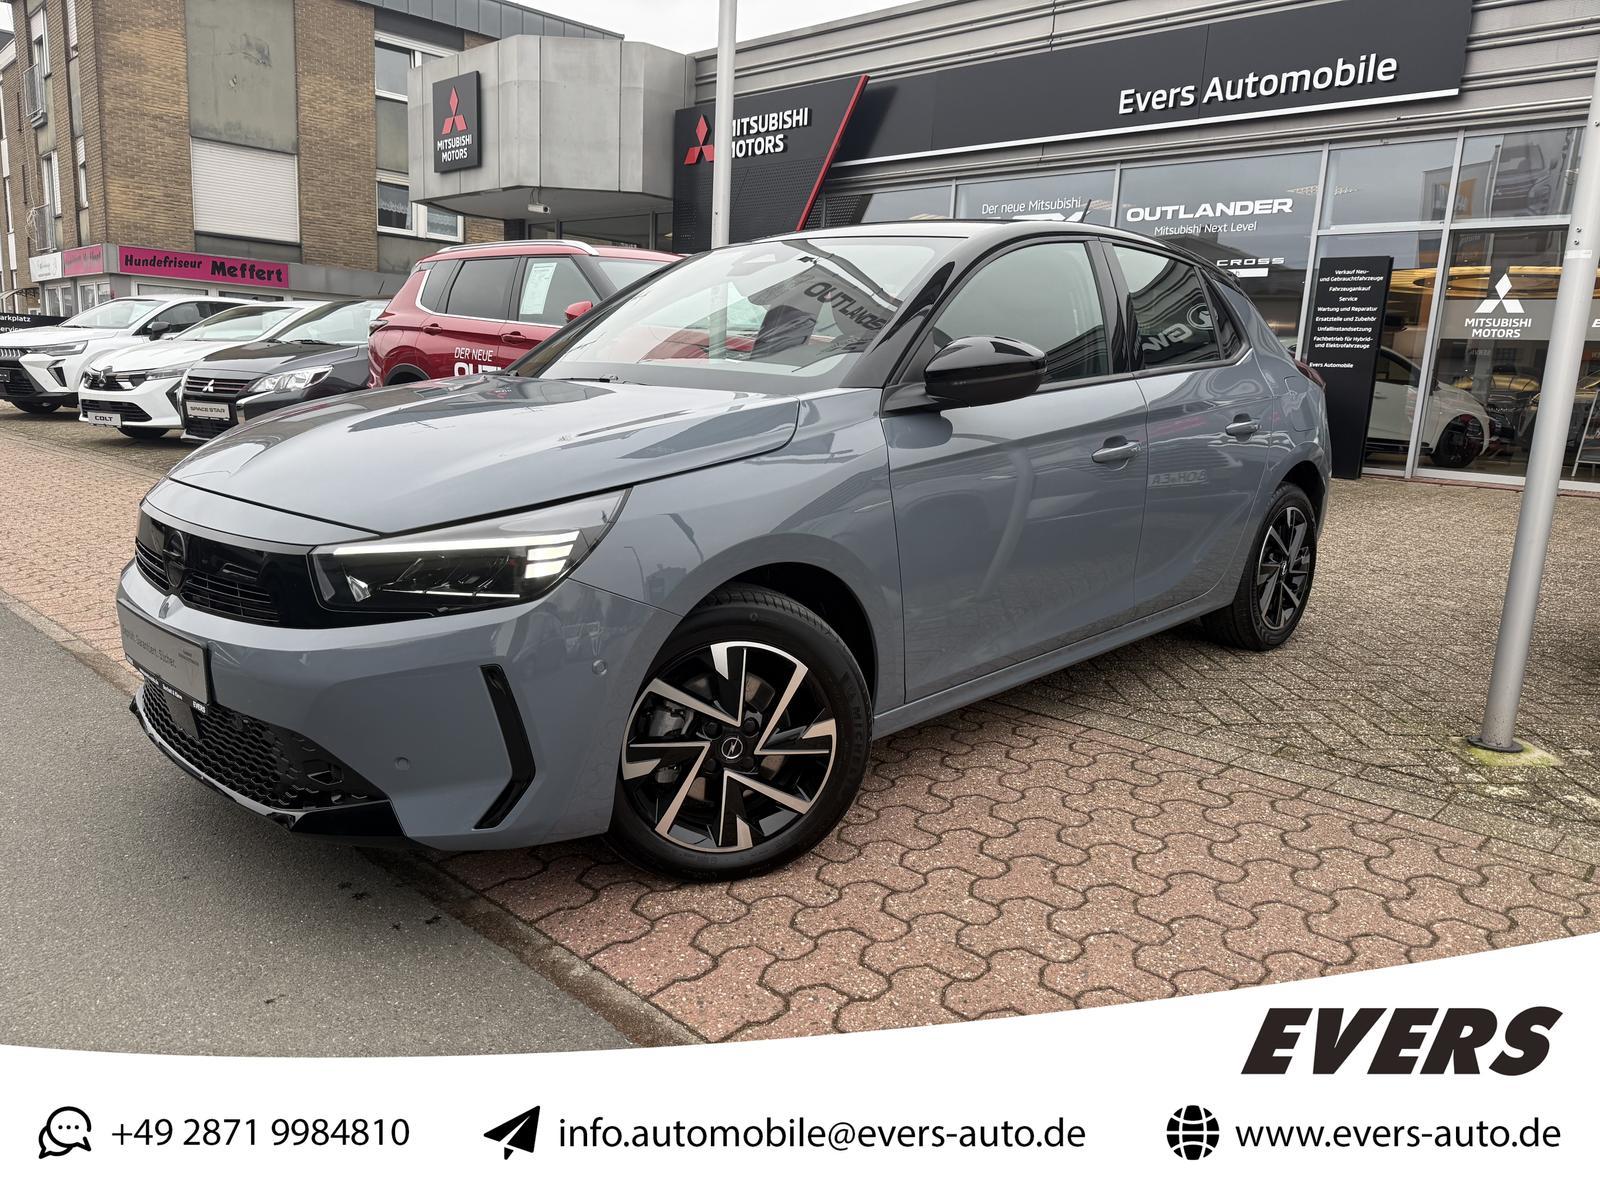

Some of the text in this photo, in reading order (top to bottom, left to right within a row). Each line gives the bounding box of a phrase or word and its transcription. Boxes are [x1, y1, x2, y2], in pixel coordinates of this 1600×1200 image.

[1118, 53, 1398, 115] Evers Automobile
[437, 134, 472, 151] MITSUBISHI
[441, 148, 468, 163] MOTORS
[982, 195, 1081, 215] Der neue Mitsubishi
[1126, 198, 1293, 222] OUTLANDER
[1154, 221, 1257, 236] Mitsubishi Next Level
[124, 254, 202, 269] Hundefriseur
[211, 260, 283, 282] Meffert
[1216, 257, 1285, 266] CROSS
[0, 315, 31, 323] arkplatz
[1464, 318, 1532, 328] MITSUBISHI
[1472, 329, 1521, 338] MOTORS
[454, 347, 494, 362] DER NEUE
